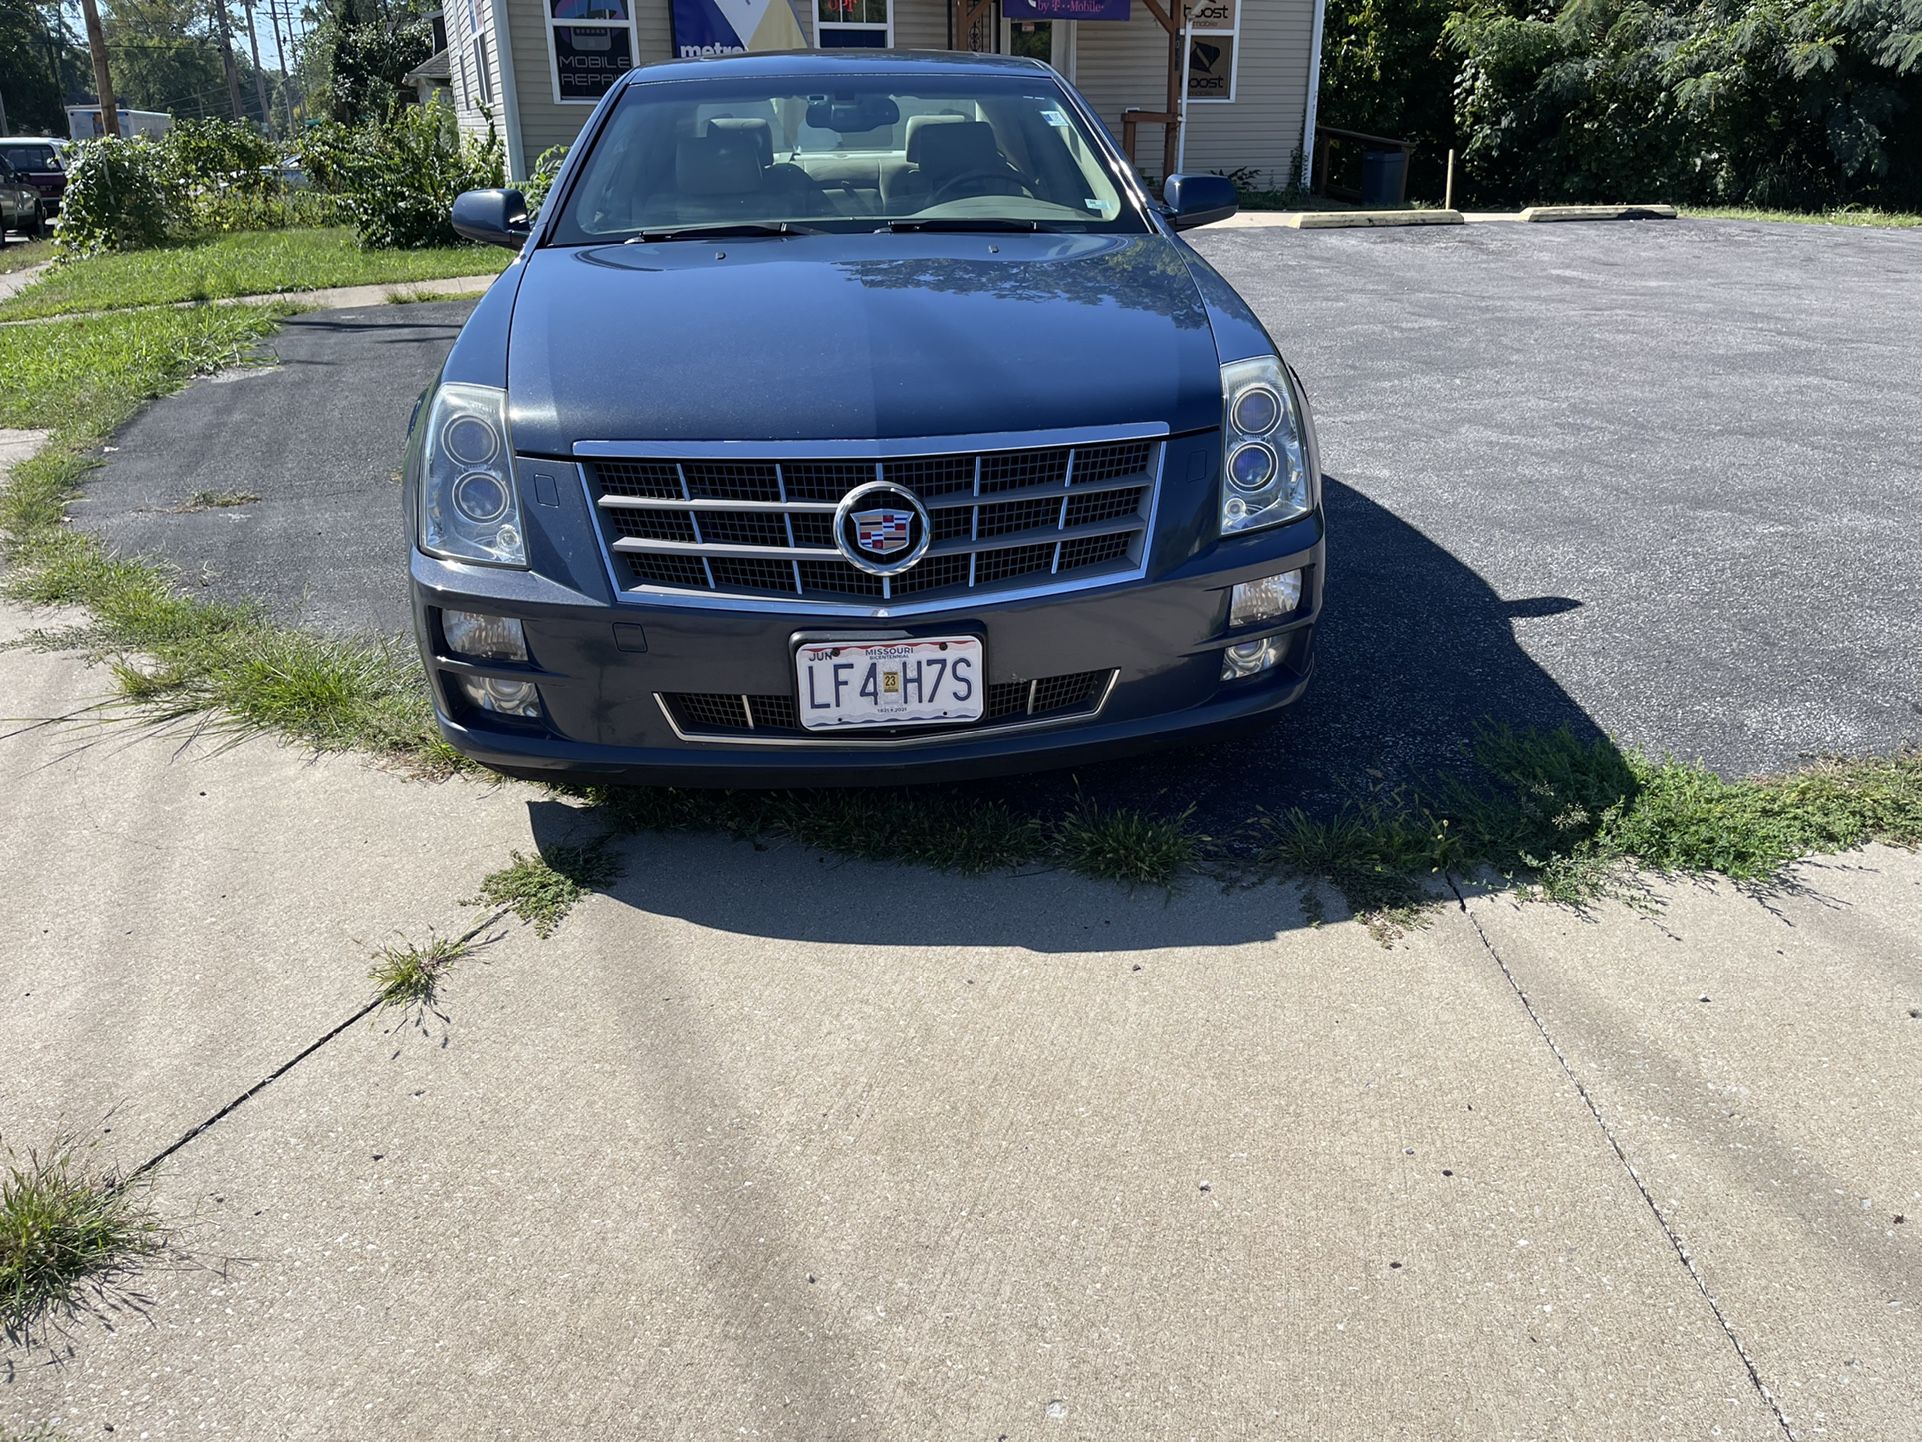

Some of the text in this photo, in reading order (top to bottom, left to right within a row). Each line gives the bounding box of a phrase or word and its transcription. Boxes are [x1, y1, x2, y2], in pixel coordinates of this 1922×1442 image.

[559, 55, 631, 69] MOBILE
[560, 73, 621, 86] REPA
[1179, 74, 1224, 89] oost
[808, 652, 833, 662] JUN
[865, 647, 914, 656] MISSOURI
[884, 675, 897, 687] 23
